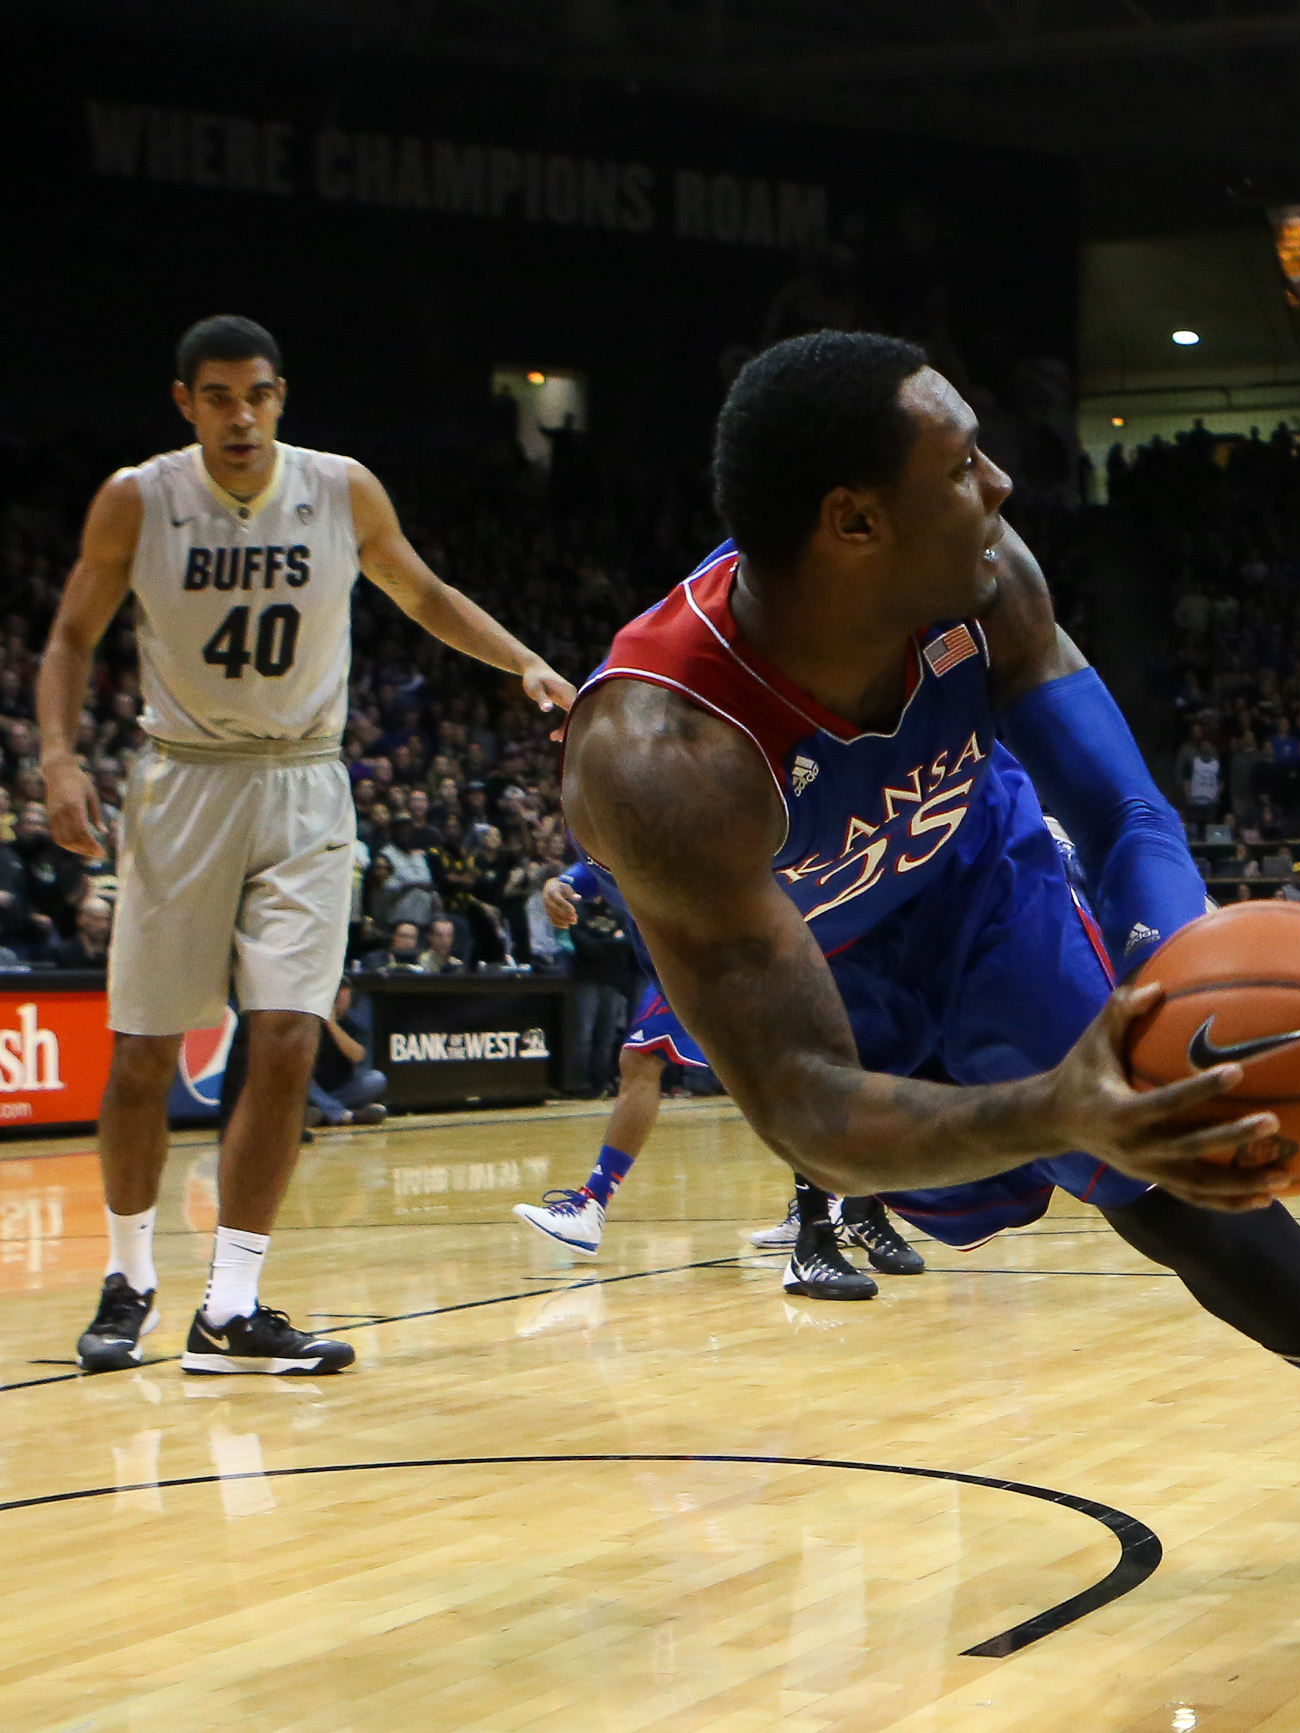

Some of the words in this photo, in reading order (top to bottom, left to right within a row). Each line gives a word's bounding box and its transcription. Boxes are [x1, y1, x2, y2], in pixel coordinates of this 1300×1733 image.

[87, 99, 296, 198] WHERE
[313, 128, 655, 236] CHAMPIONS
[184, 544, 312, 591] BUFFS
[202, 603, 301, 679] 40
[776, 731, 987, 883] KANSA
[803, 778, 974, 922] 25
[0, 1002, 67, 1093] sh
[390, 1033, 448, 1062] BANK
[465, 1031, 520, 1059] WEST
